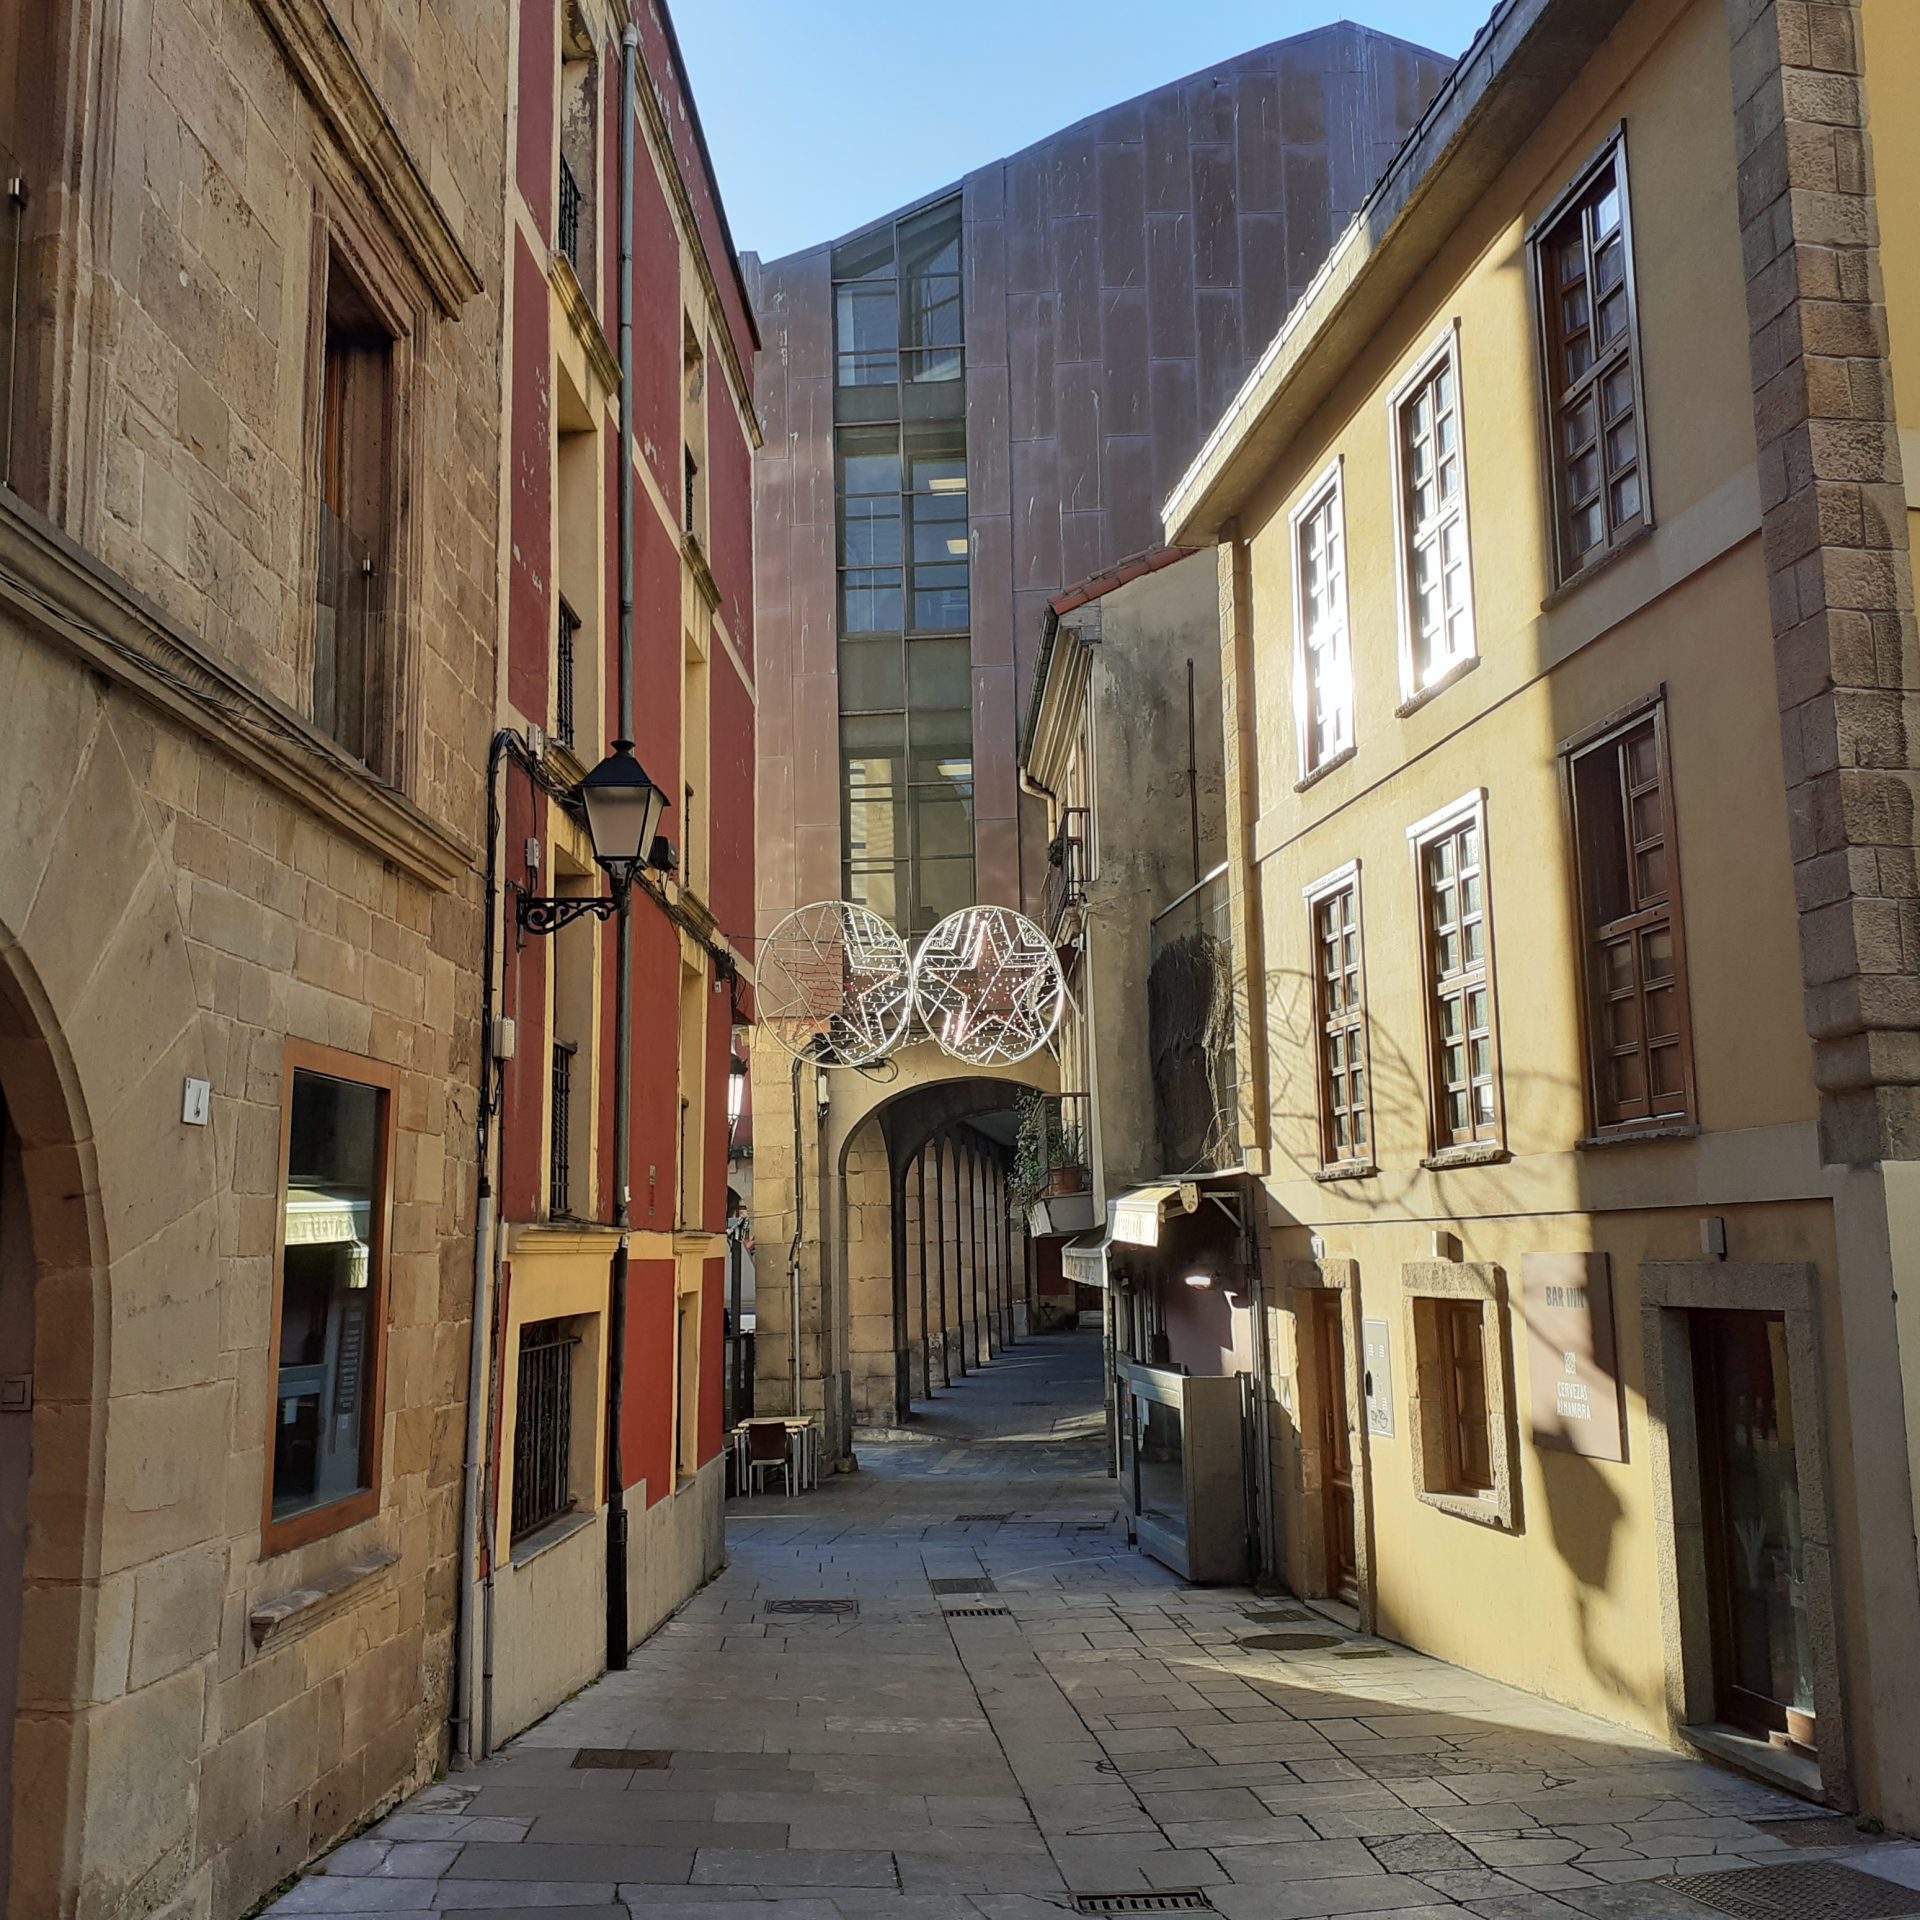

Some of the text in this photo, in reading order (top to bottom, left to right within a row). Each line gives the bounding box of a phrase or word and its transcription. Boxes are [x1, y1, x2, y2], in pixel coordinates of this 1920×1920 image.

[1545, 1286, 1564, 1307] BAR
[1557, 1382, 1588, 1401] CERVEZAS
[1556, 1399, 1592, 1421] ALHAMBRA
